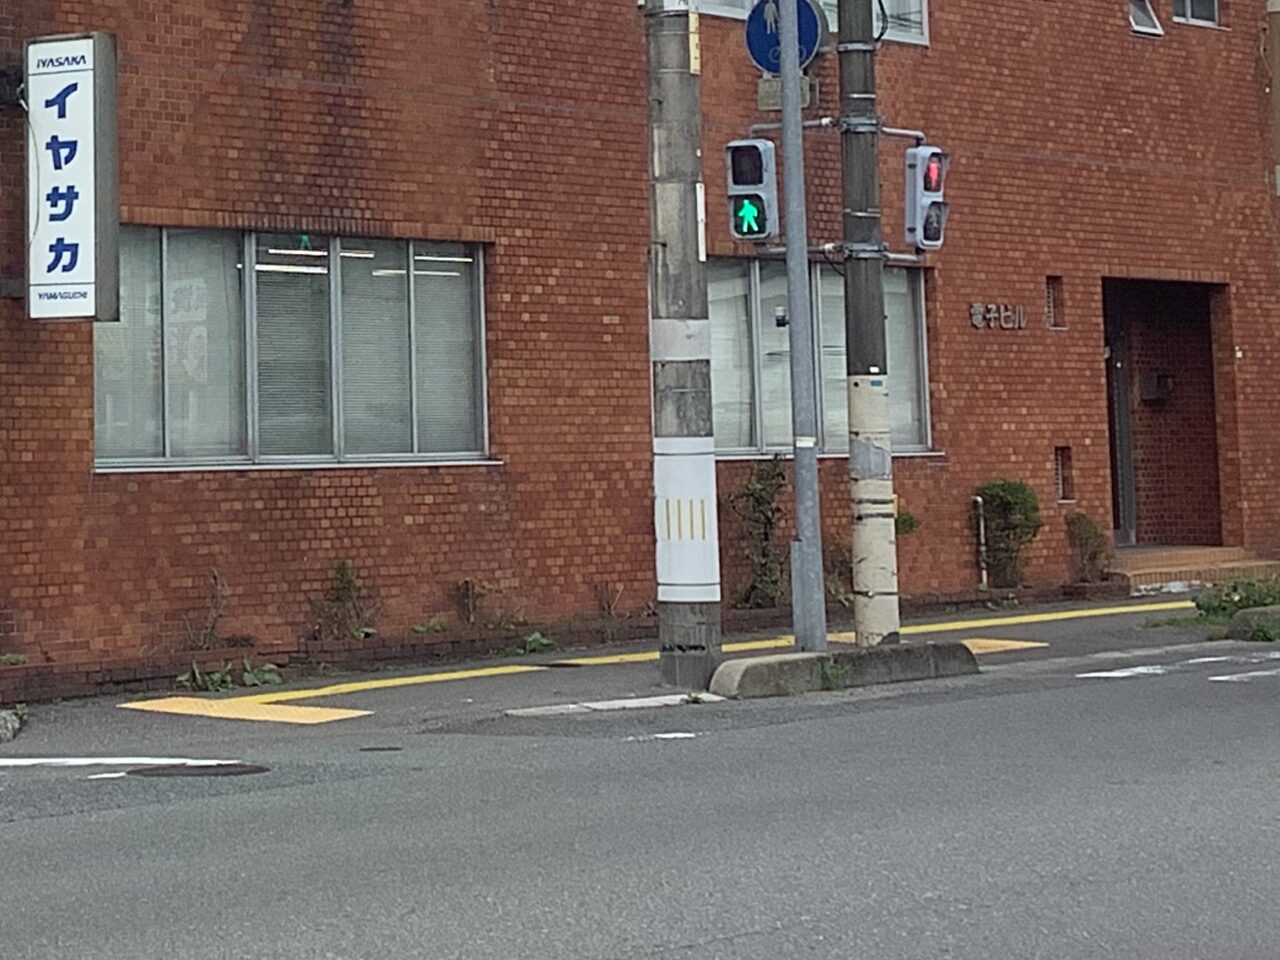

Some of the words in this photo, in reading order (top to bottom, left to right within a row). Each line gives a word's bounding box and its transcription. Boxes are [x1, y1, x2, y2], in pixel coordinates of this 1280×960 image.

[36, 54, 87, 69] IYASAKA
[44, 82, 79, 273] イヤサカ
[970, 303, 1028, 328] 電子ビル
